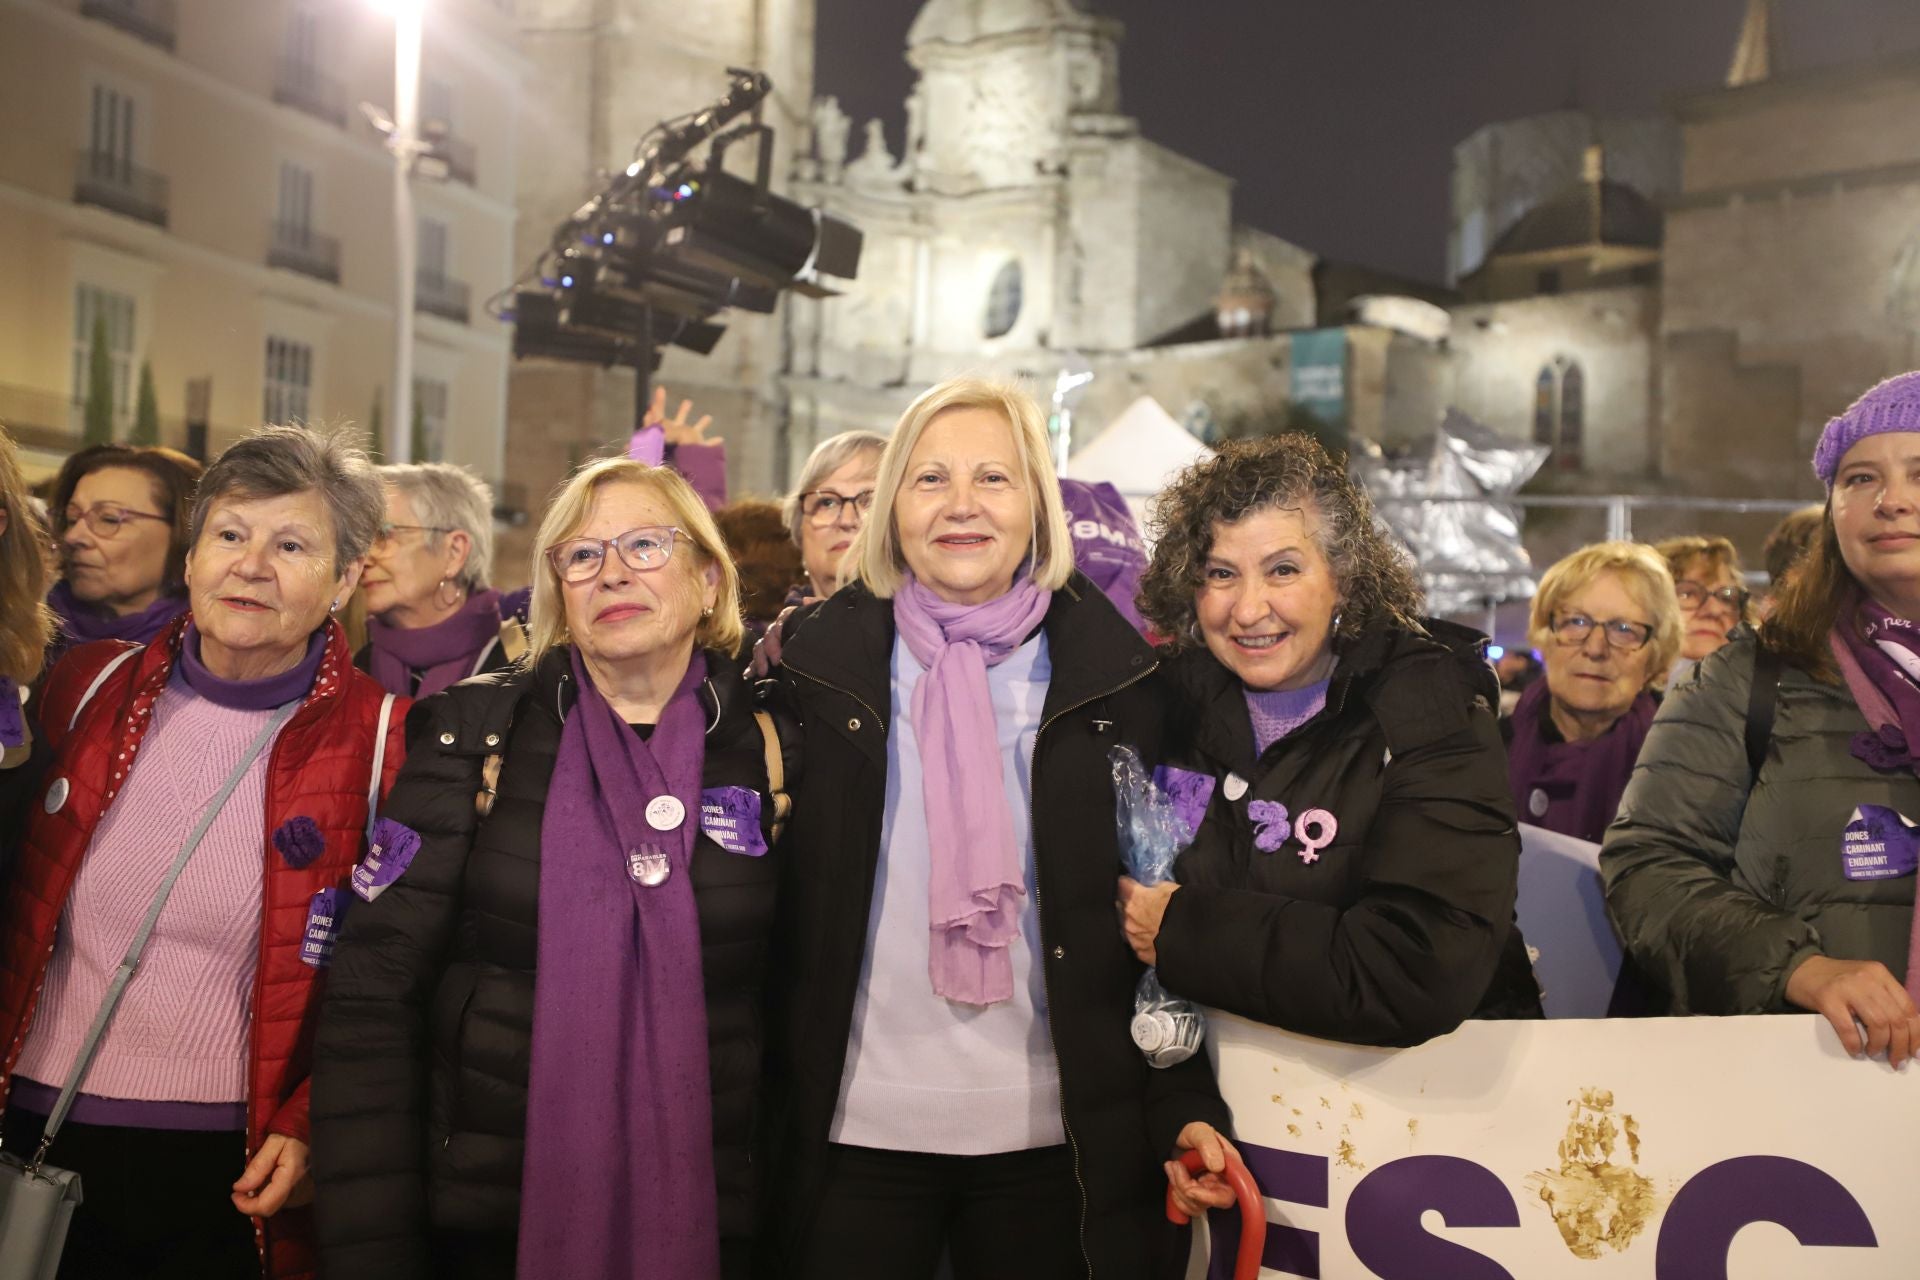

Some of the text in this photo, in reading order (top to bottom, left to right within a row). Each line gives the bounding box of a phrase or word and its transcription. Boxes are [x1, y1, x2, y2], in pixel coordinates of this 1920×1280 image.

[702, 806, 724, 814] DONES
[704, 816, 737, 828] CAMINANT
[1845, 831, 1869, 841] DONES
[1846, 843, 1885, 855] CAMINANT
[1848, 856, 1888, 867] ENDAVANT
[311, 914, 334, 928] DONES
